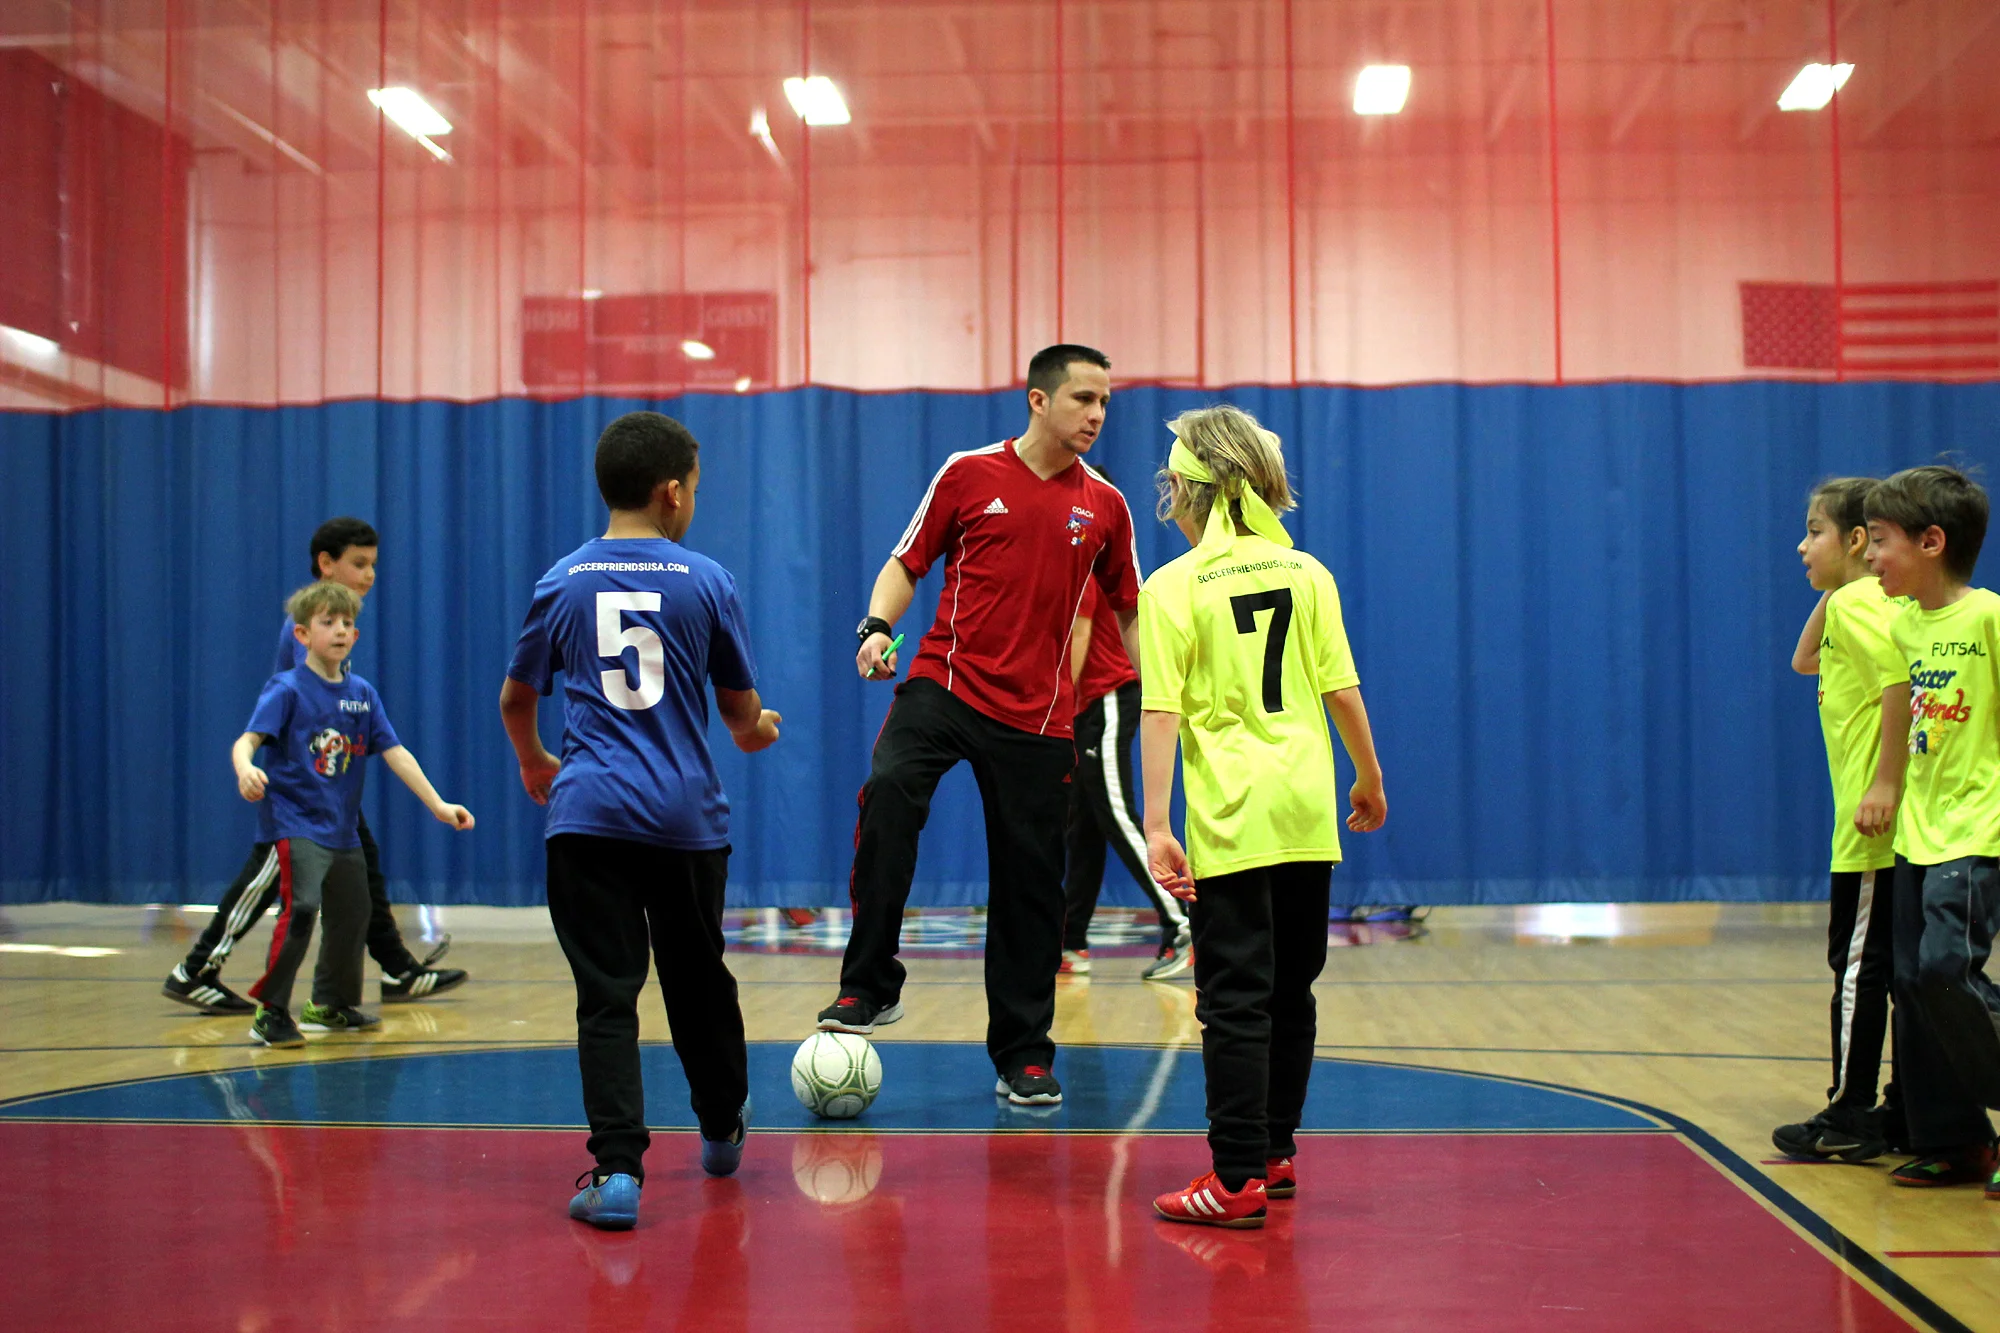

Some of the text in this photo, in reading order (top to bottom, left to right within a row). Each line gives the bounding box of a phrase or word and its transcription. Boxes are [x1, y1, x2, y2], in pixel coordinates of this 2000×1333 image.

[1072, 506, 1094, 519] COACH
[568, 562, 689, 576] SOCCERFRIENDSUSA.COM
[596, 591, 665, 711] 5
[1229, 587, 1293, 714] 7
[1931, 641, 1987, 657] FUTSAL
